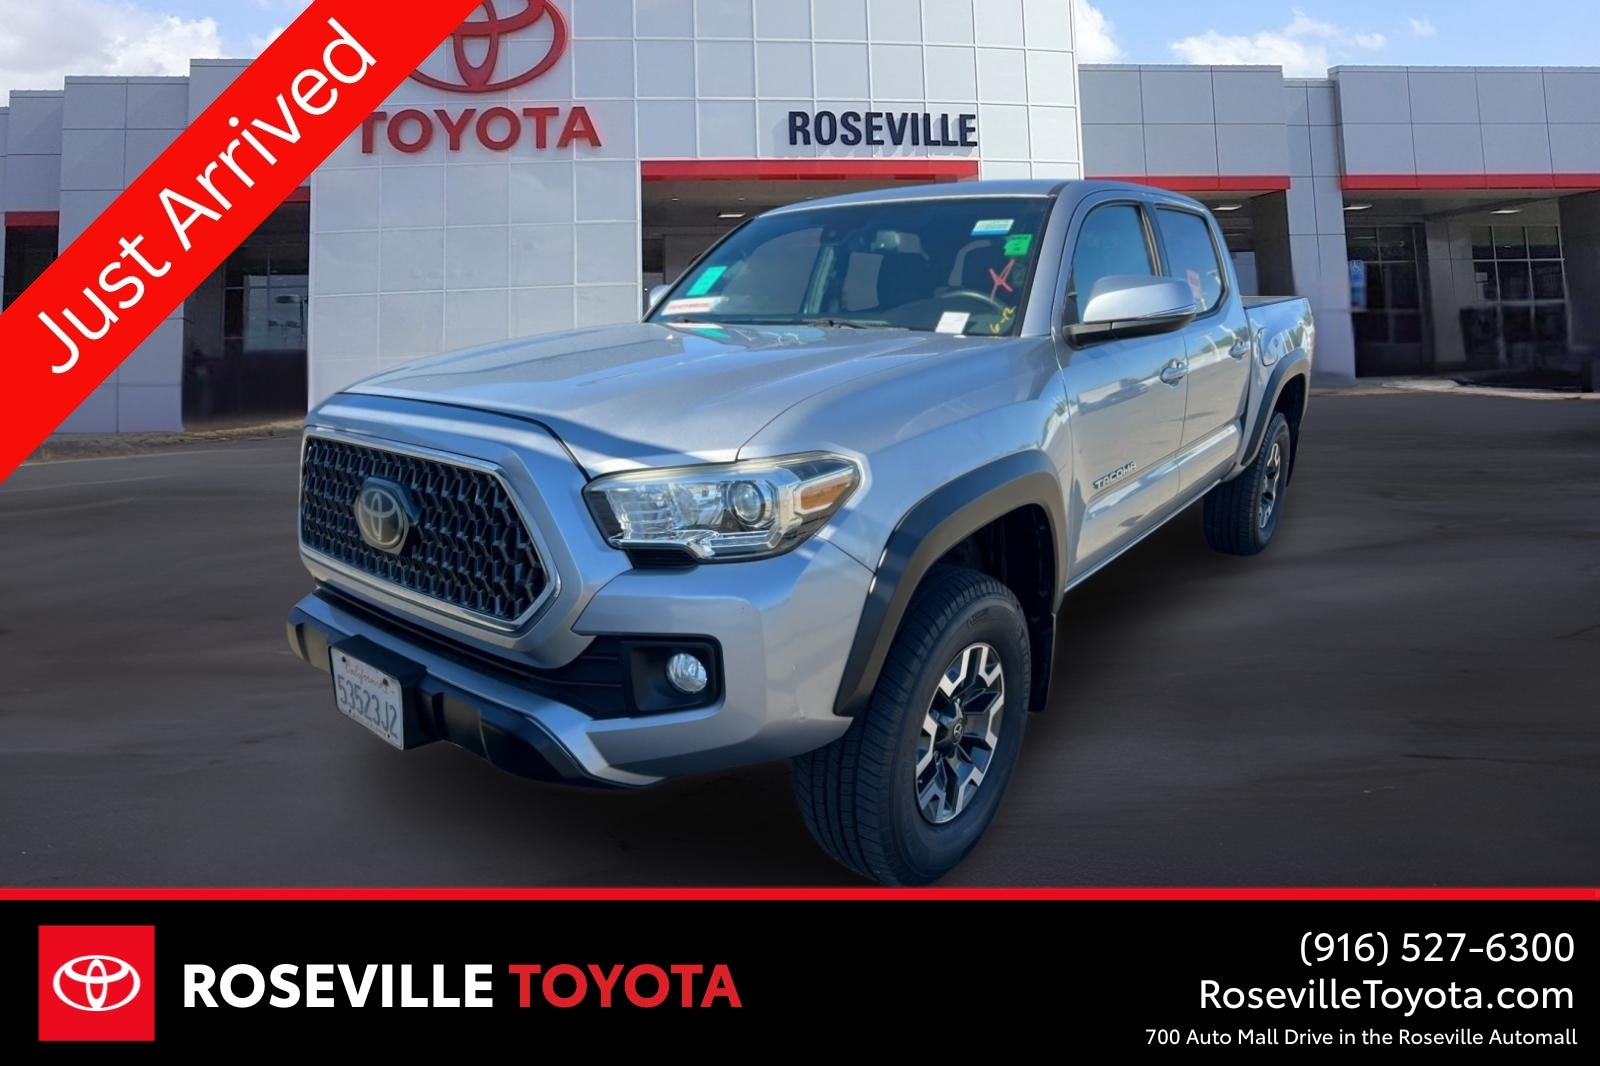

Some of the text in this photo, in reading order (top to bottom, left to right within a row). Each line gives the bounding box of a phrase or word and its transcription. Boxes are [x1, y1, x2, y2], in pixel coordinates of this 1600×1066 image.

[361, 106, 602, 154] TOYOTA
[788, 110, 978, 147] ROSEVILLE
[1092, 459, 1137, 489] TACOMA
[345, 661, 388, 689] California
[337, 674, 399, 739] 53523J2
